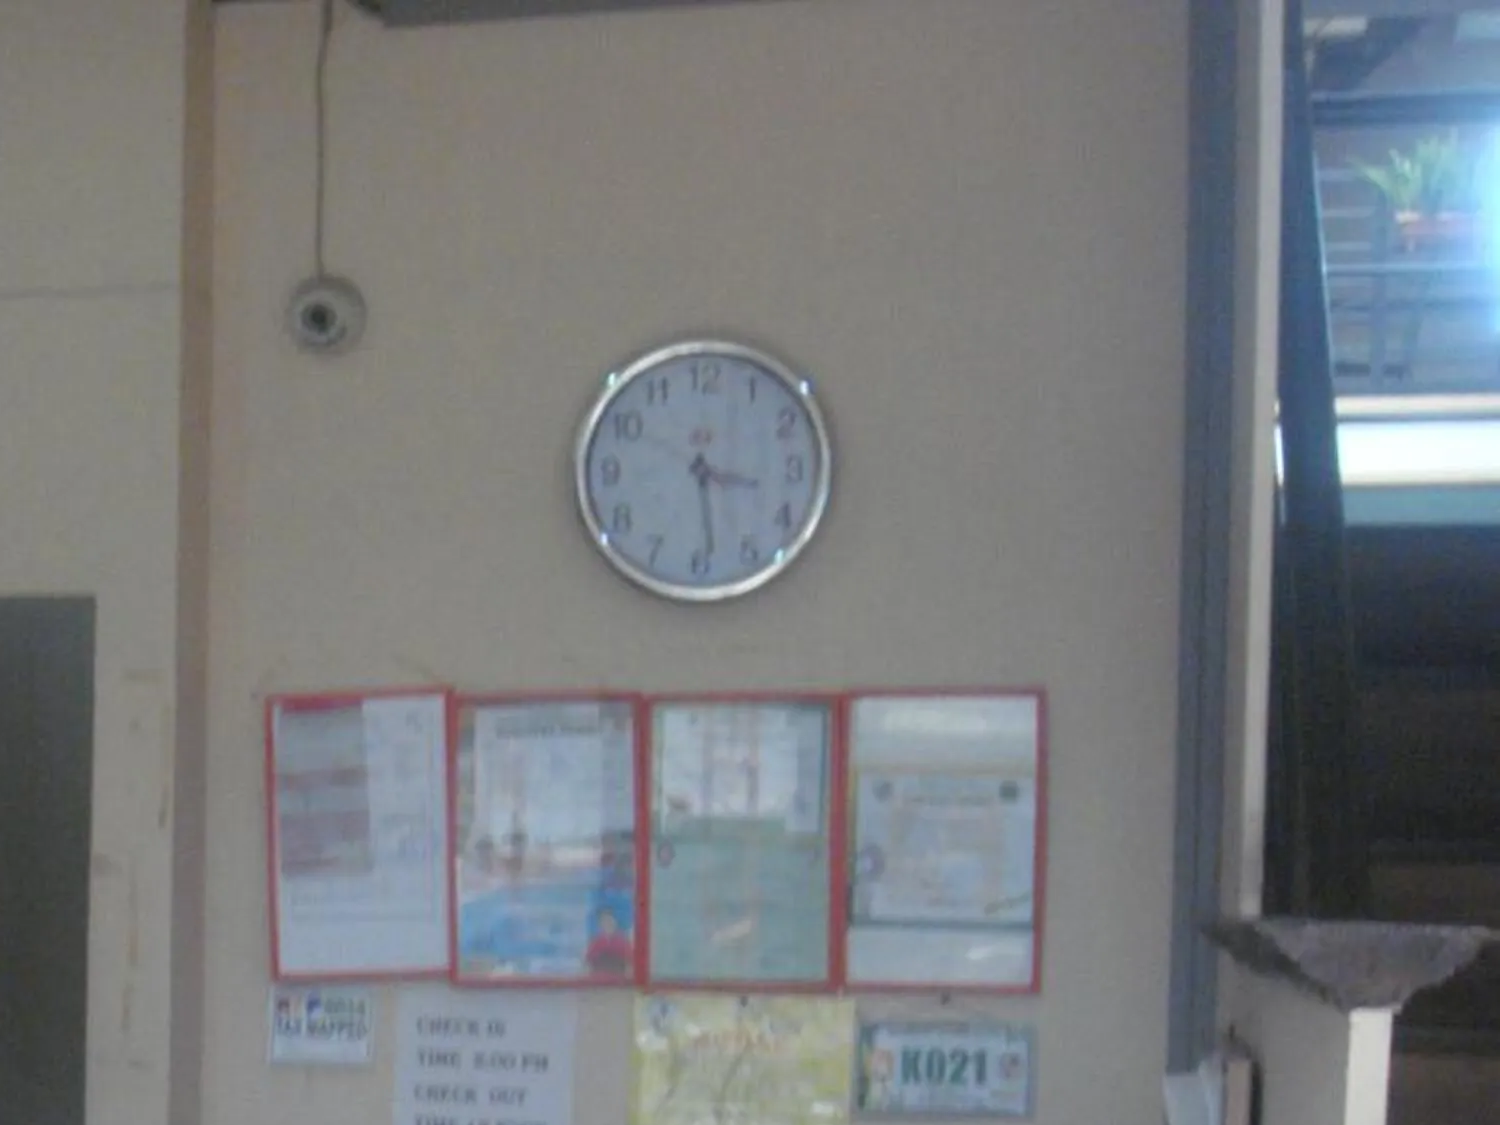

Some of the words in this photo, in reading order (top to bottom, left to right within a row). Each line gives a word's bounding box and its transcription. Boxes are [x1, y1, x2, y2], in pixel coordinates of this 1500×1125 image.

[648, 376, 670, 405] 11
[690, 363, 721, 395] 12
[746, 376, 756, 403] 1
[615, 411, 643, 442] 10
[776, 406, 798, 439] 2
[774, 503, 792, 529] 4
[901, 1047, 988, 1085] K021
